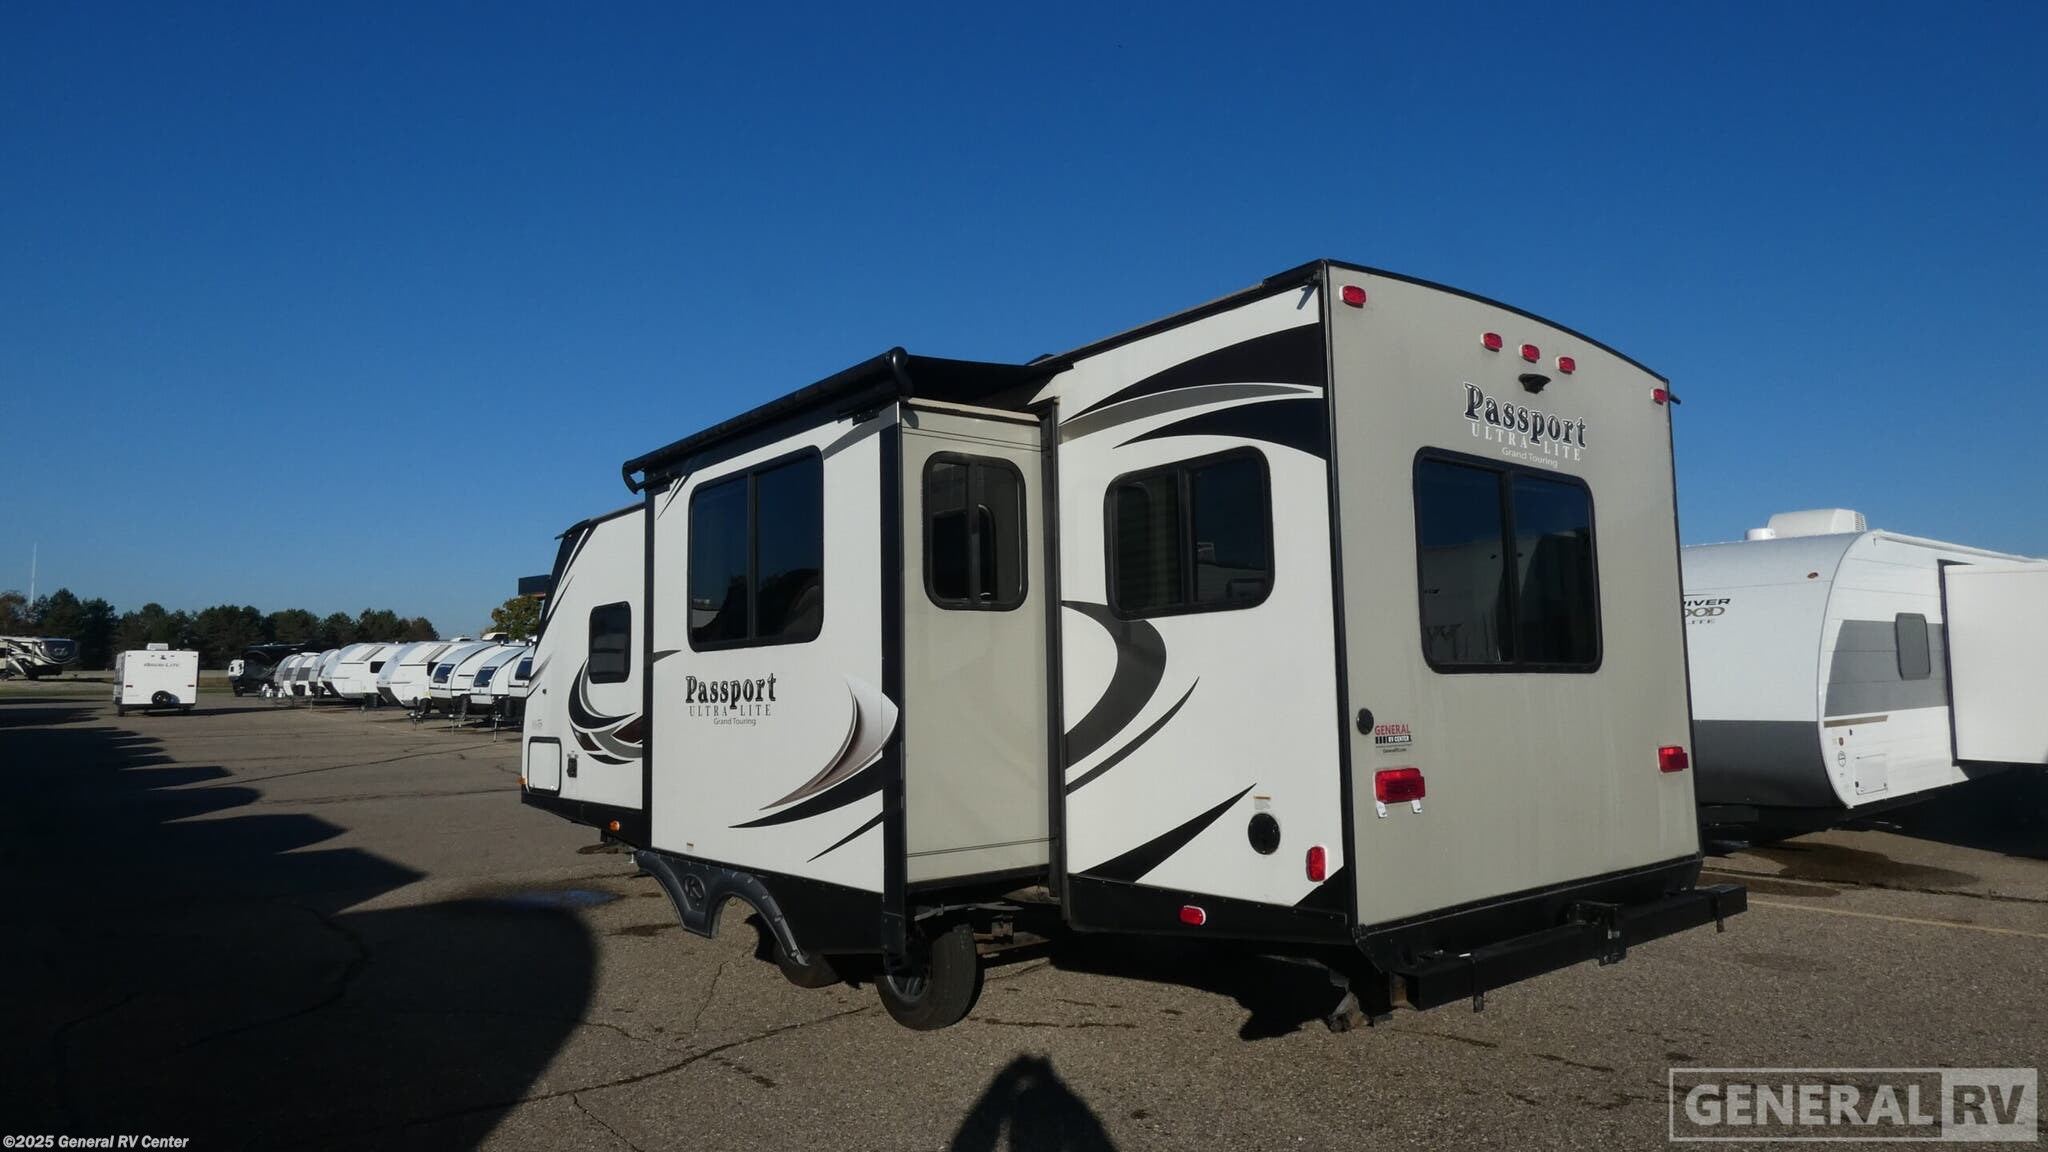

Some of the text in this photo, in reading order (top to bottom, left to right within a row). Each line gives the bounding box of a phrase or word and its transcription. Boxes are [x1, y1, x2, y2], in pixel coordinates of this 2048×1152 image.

[1464, 382, 1586, 449] Passport
[1471, 422, 1581, 461] ULTRA LITE
[1502, 448, 1558, 468] Grand Touring
[685, 673, 776, 709] Passport
[689, 704, 771, 716] ULTRA LITE
[713, 717, 756, 726] Grand Touring
[1375, 724, 1410, 735] GENERAL
